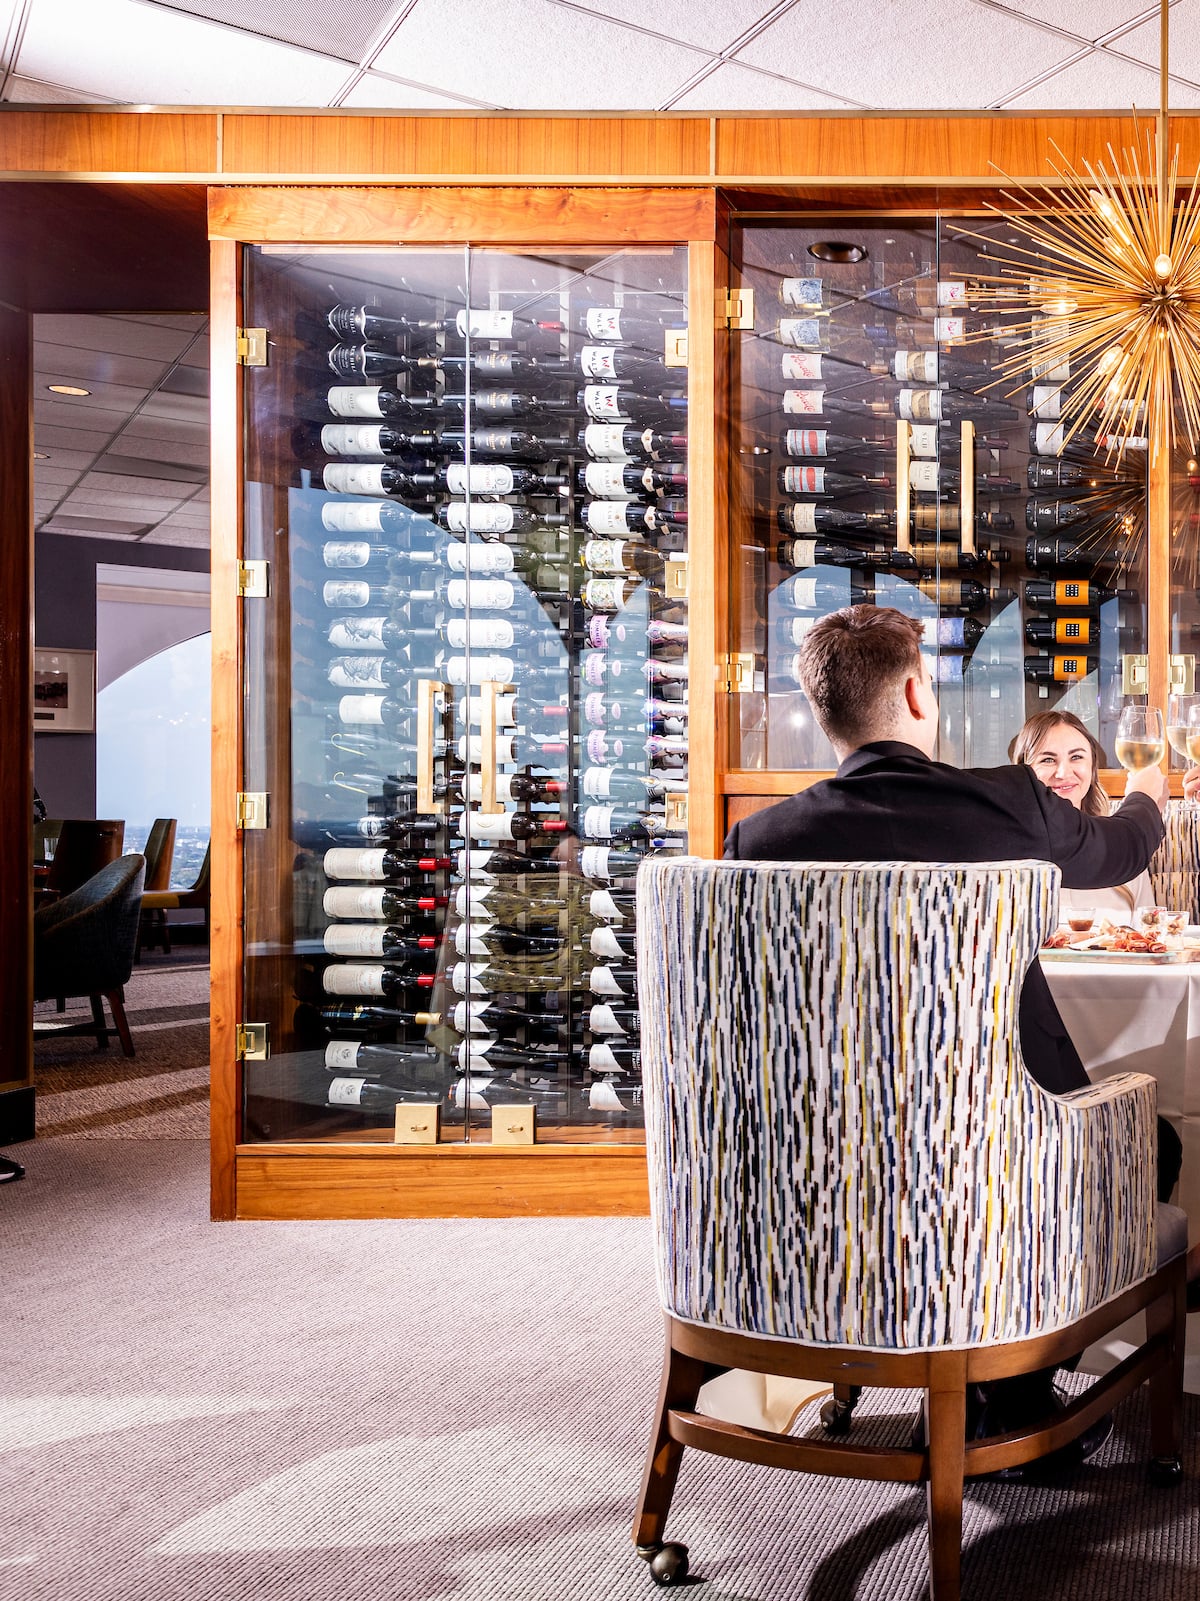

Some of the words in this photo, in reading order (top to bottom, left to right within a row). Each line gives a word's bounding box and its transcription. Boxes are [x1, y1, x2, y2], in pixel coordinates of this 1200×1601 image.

[596, 312, 604, 333] WALT
[591, 351, 599, 372] WALT
[594, 390, 602, 411] WALT
